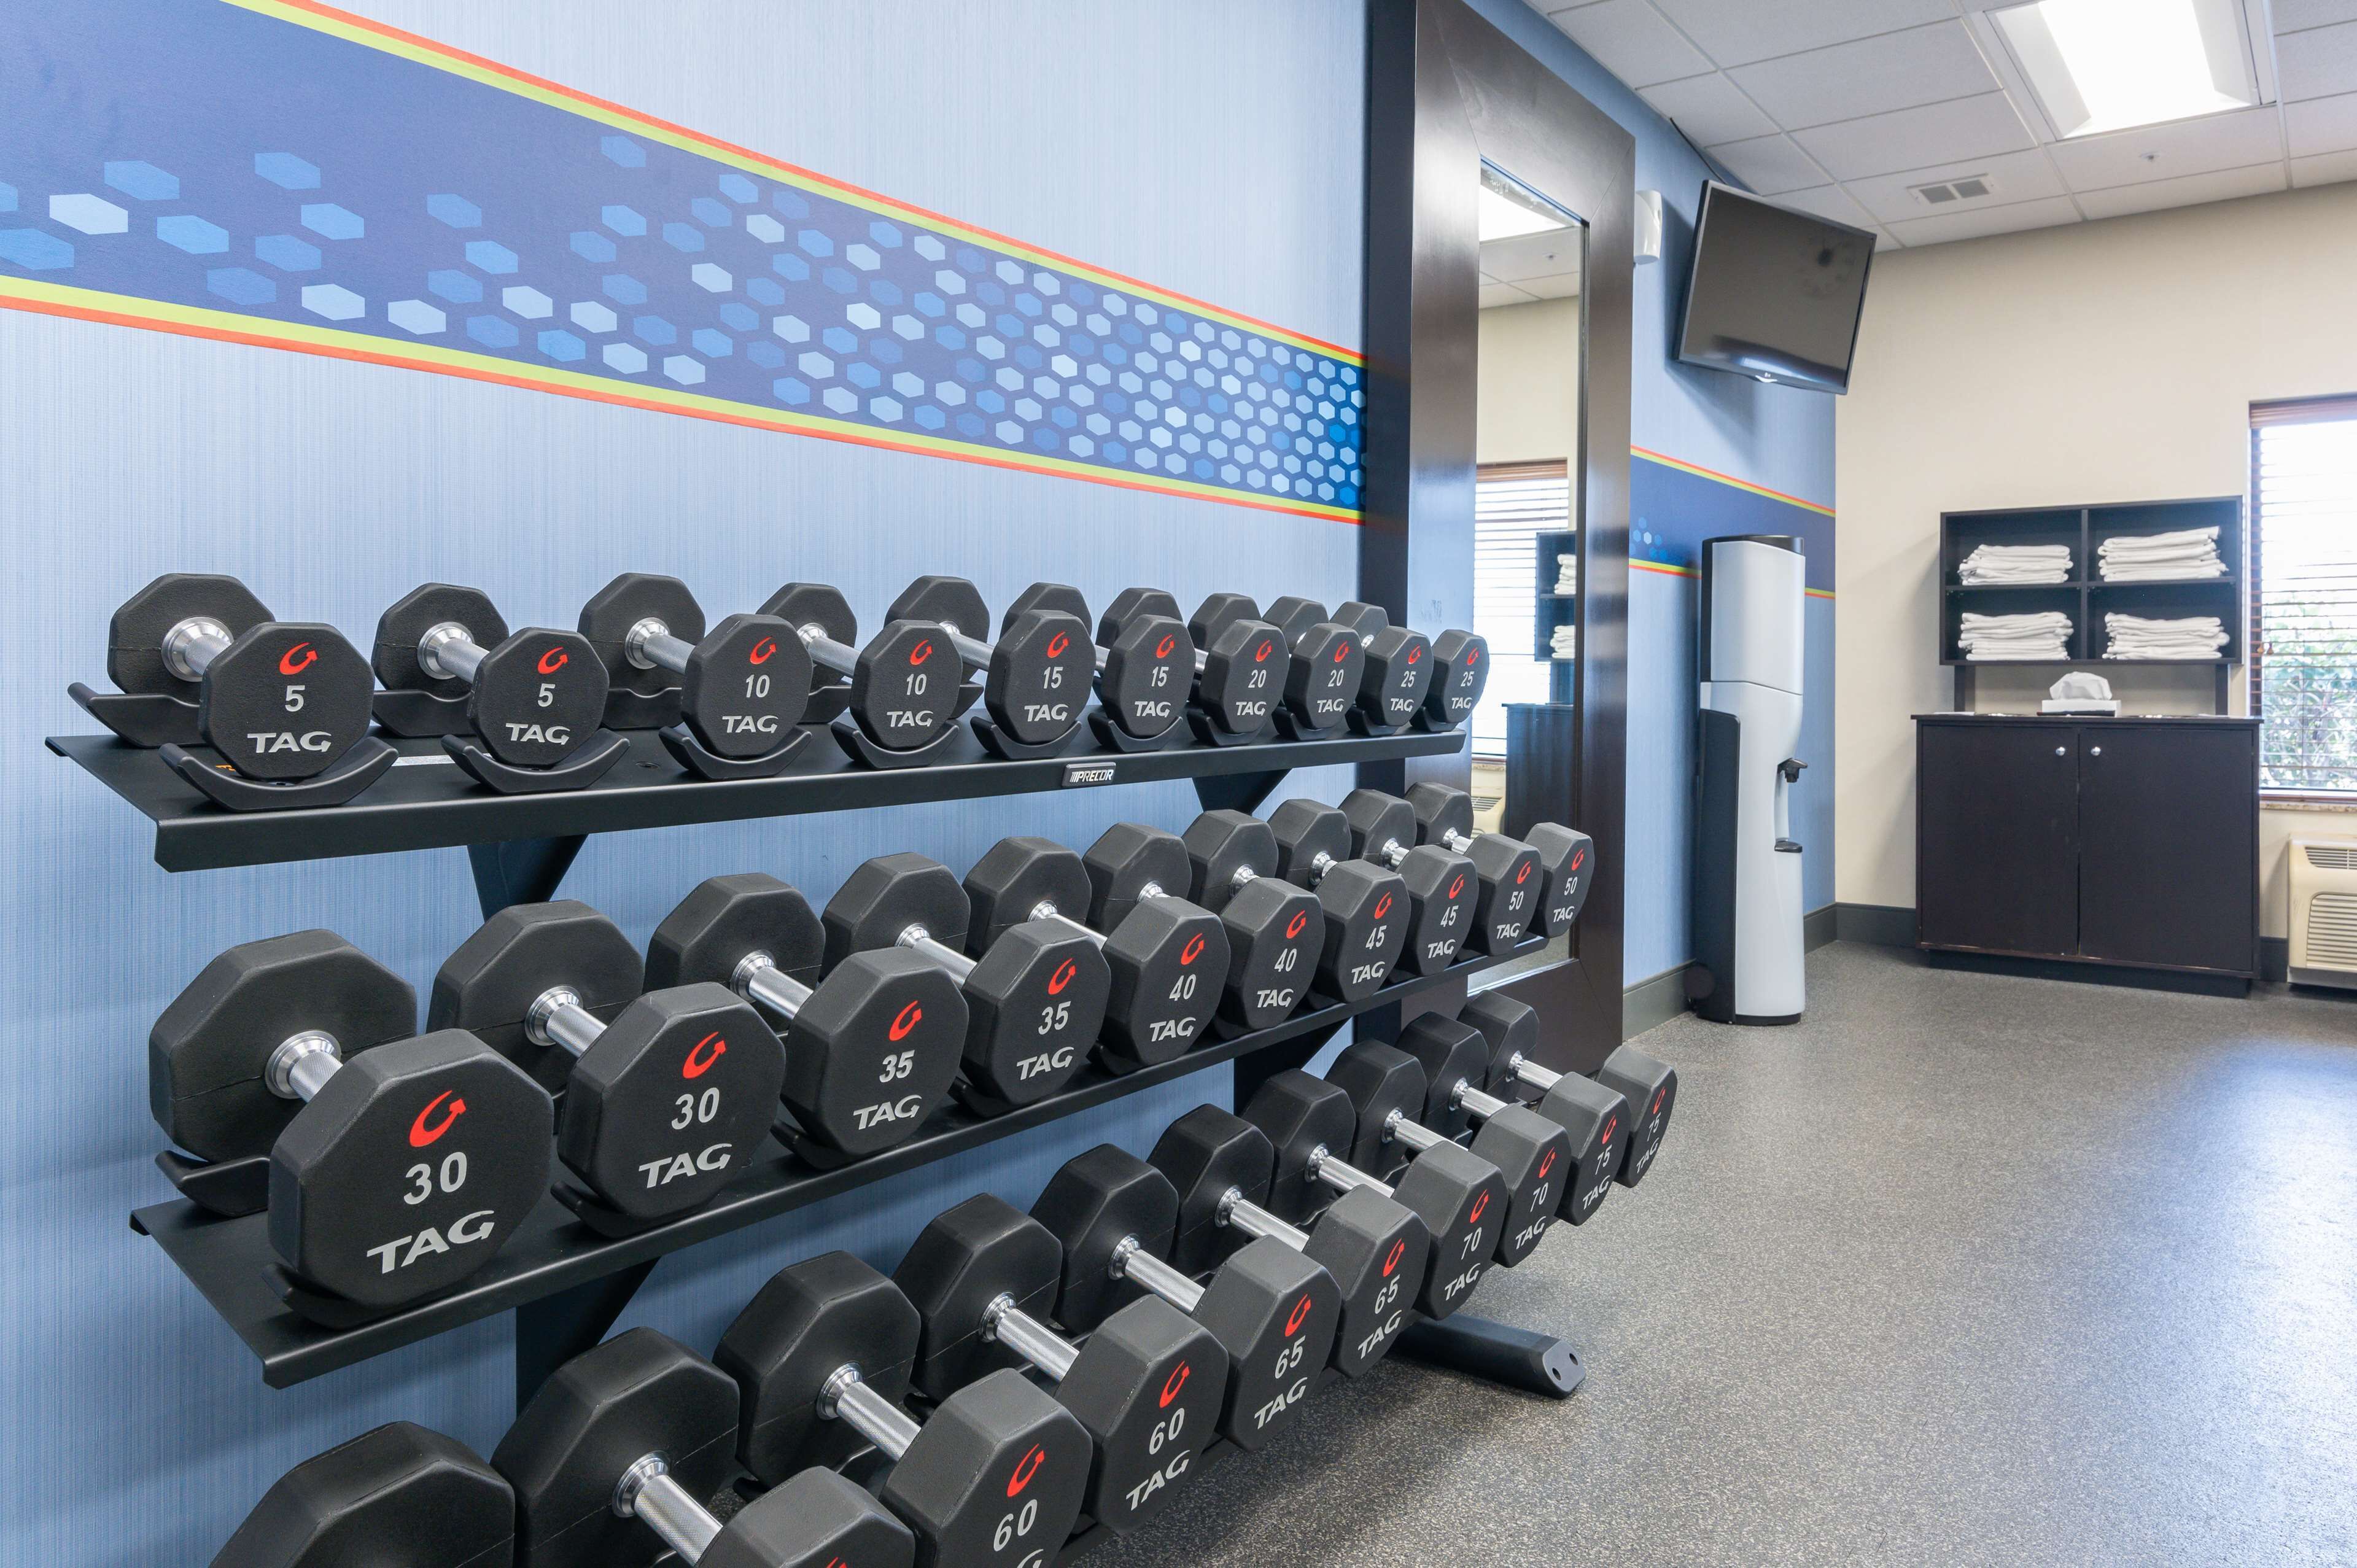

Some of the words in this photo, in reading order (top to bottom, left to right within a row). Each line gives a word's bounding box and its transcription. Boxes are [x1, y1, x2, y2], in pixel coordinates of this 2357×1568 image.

[745, 674, 771, 698] 10
[906, 673, 927, 696] 10
[1043, 666, 1064, 689] 15
[1151, 666, 1170, 687] 15
[1248, 669, 1267, 688] 20
[1327, 669, 1345, 688] 20
[1400, 670, 1416, 688] 25
[1460, 670, 1475, 687] 25
[284, 685, 306, 712] 5
[537, 683, 556, 707] 5
[1316, 698, 1345, 713] TAG
[1390, 697, 1415, 713] TAG
[1451, 696, 1474, 710] TAG
[886, 710, 934, 728] TAG
[1023, 704, 1069, 722] TAG
[1134, 701, 1171, 718] TAG
[1235, 701, 1267, 716] TAG
[505, 723, 570, 745] TAG
[721, 715, 779, 734] TAG
[247, 731, 332, 753] TAG
[1075, 769, 1114, 783] PRECOR
[1564, 876, 1578, 896] 50
[1509, 890, 1524, 911] 50
[1440, 905, 1459, 928] 45
[1553, 906, 1575, 923] TAG
[1365, 925, 1388, 950] 45
[1496, 922, 1521, 939] TAG
[1274, 948, 1297, 972] 40
[1427, 939, 1456, 959] TAG
[1351, 961, 1386, 984] TAG
[1168, 974, 1197, 1001] 40
[1257, 988, 1294, 1008] TAG
[1038, 1001, 1071, 1035] 35
[1149, 1017, 1196, 1042] TAG
[879, 1049, 915, 1083] 35
[1016, 1046, 1074, 1081] TAG
[671, 1087, 720, 1130] 30
[853, 1094, 922, 1130] TAG
[1647, 1111, 1661, 1142] 75
[638, 1143, 732, 1189] TAG
[1594, 1144, 1612, 1176] 75
[1636, 1137, 1660, 1174] TAG
[403, 1151, 467, 1205] 30
[1530, 1182, 1549, 1213] 70
[1582, 1174, 1611, 1211] TAG
[367, 1210, 495, 1274] TAG
[1461, 1227, 1482, 1260] 70
[1515, 1216, 1546, 1250] TAG
[1375, 1274, 1400, 1315] 65
[1444, 1263, 1481, 1302] TAG
[1357, 1310, 1402, 1359] TAG
[1275, 1335, 1306, 1380] 65
[1254, 1376, 1308, 1430] TAG
[1149, 1407, 1185, 1456] 60
[1125, 1450, 1190, 1511] TAG
[993, 1499, 1038, 1552] 60
